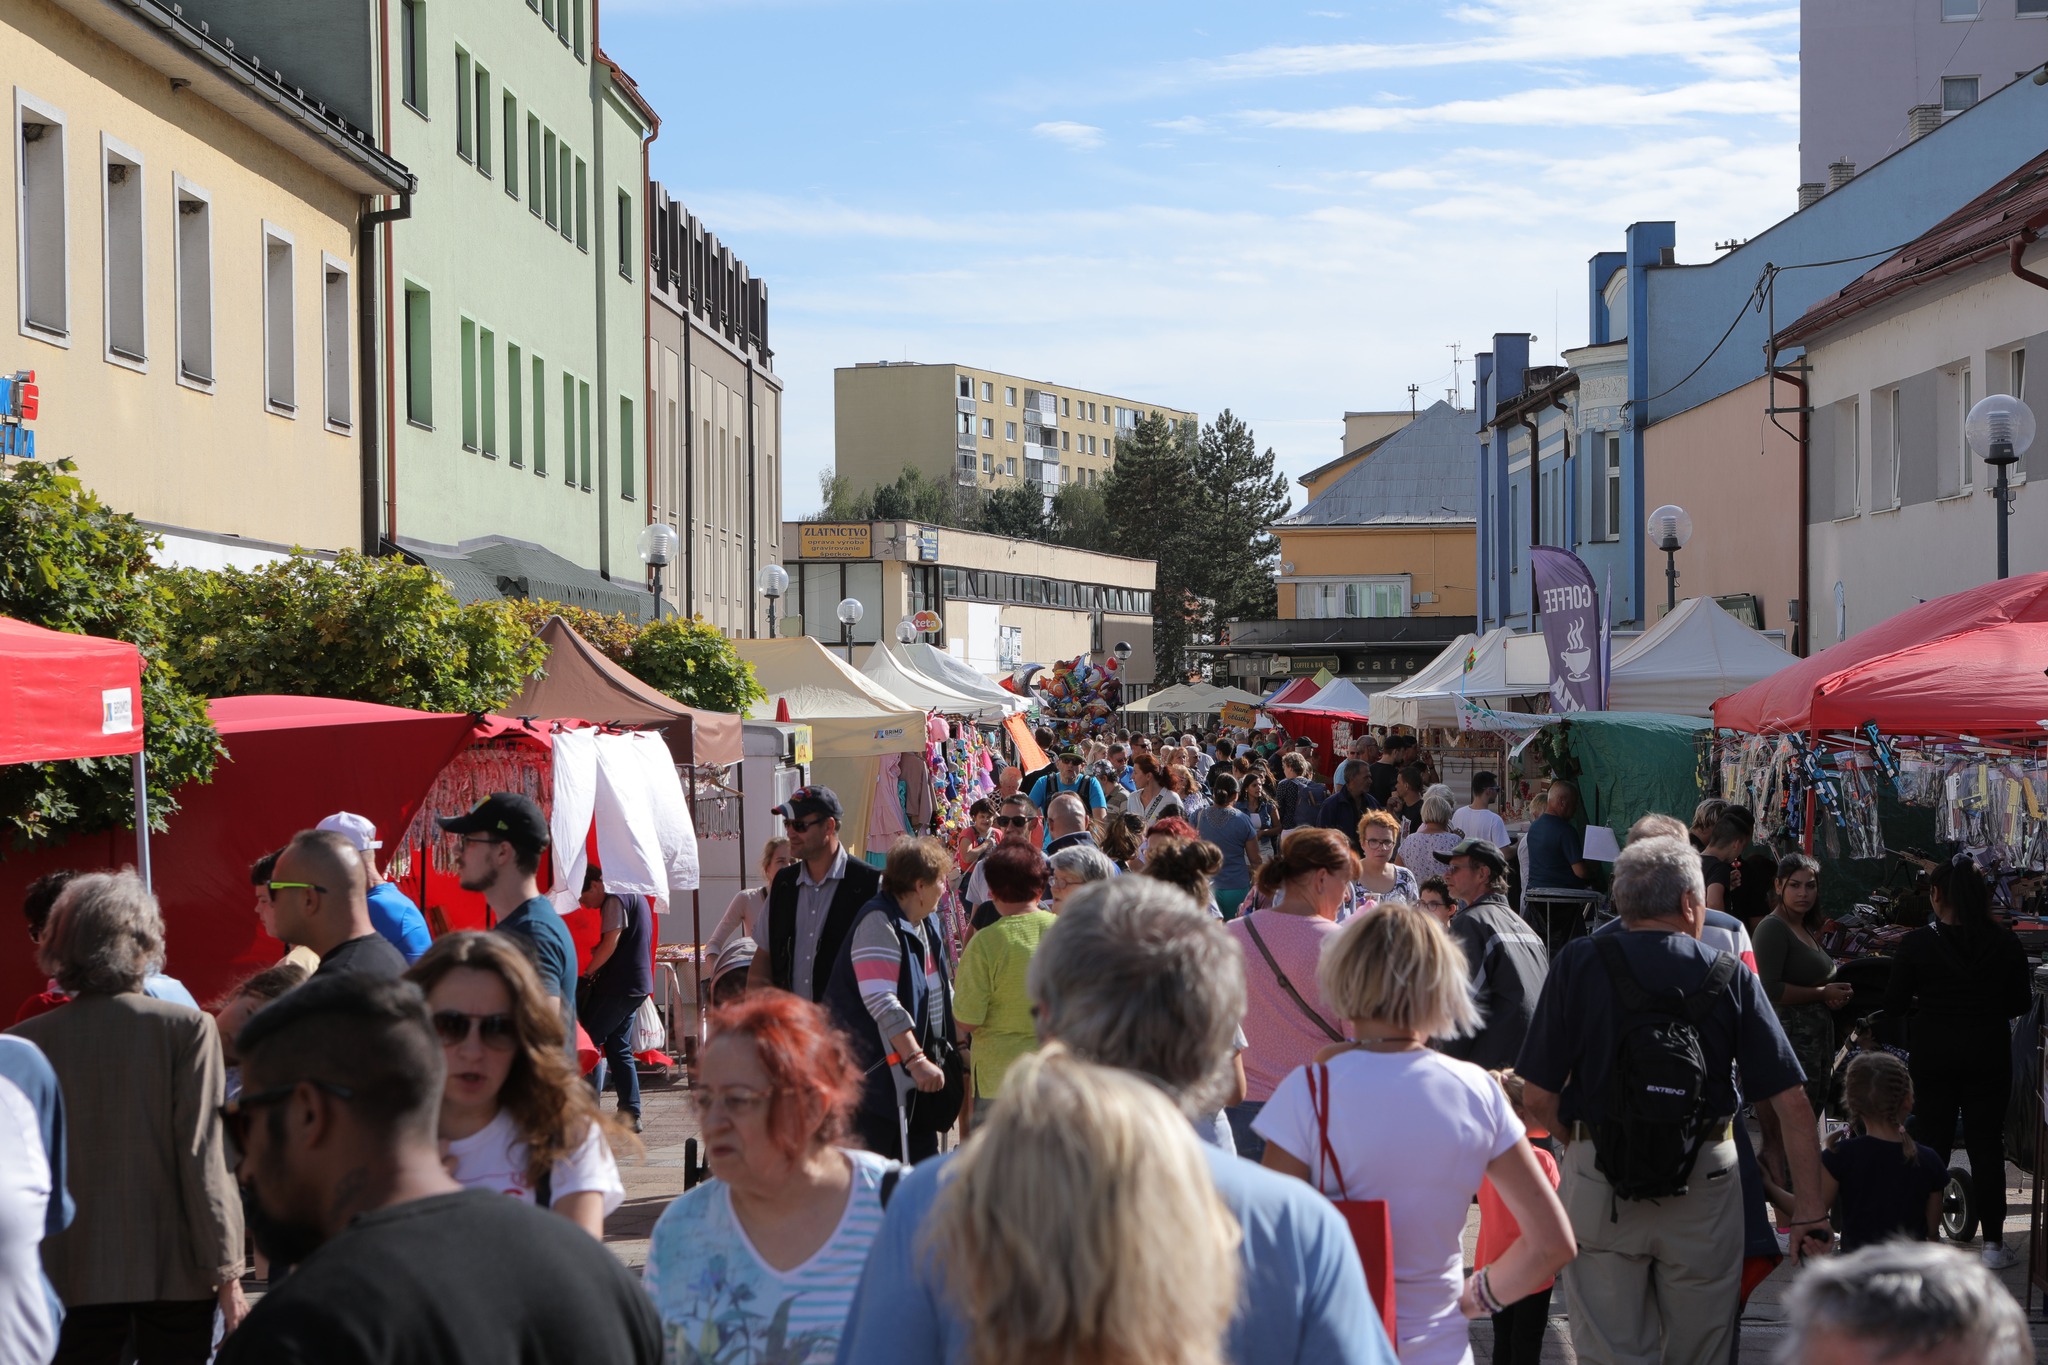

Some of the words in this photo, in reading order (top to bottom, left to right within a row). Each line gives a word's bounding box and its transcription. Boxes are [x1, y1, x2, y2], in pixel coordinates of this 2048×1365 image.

[915, 619, 936, 628] teta
[1245, 660, 1266, 672] caf
[1293, 661, 1310, 669] COFFEE
[1356, 657, 1415, 670] café
[884, 728, 903, 736] BRIMO
[1646, 1084, 1686, 1096] EXTEND
